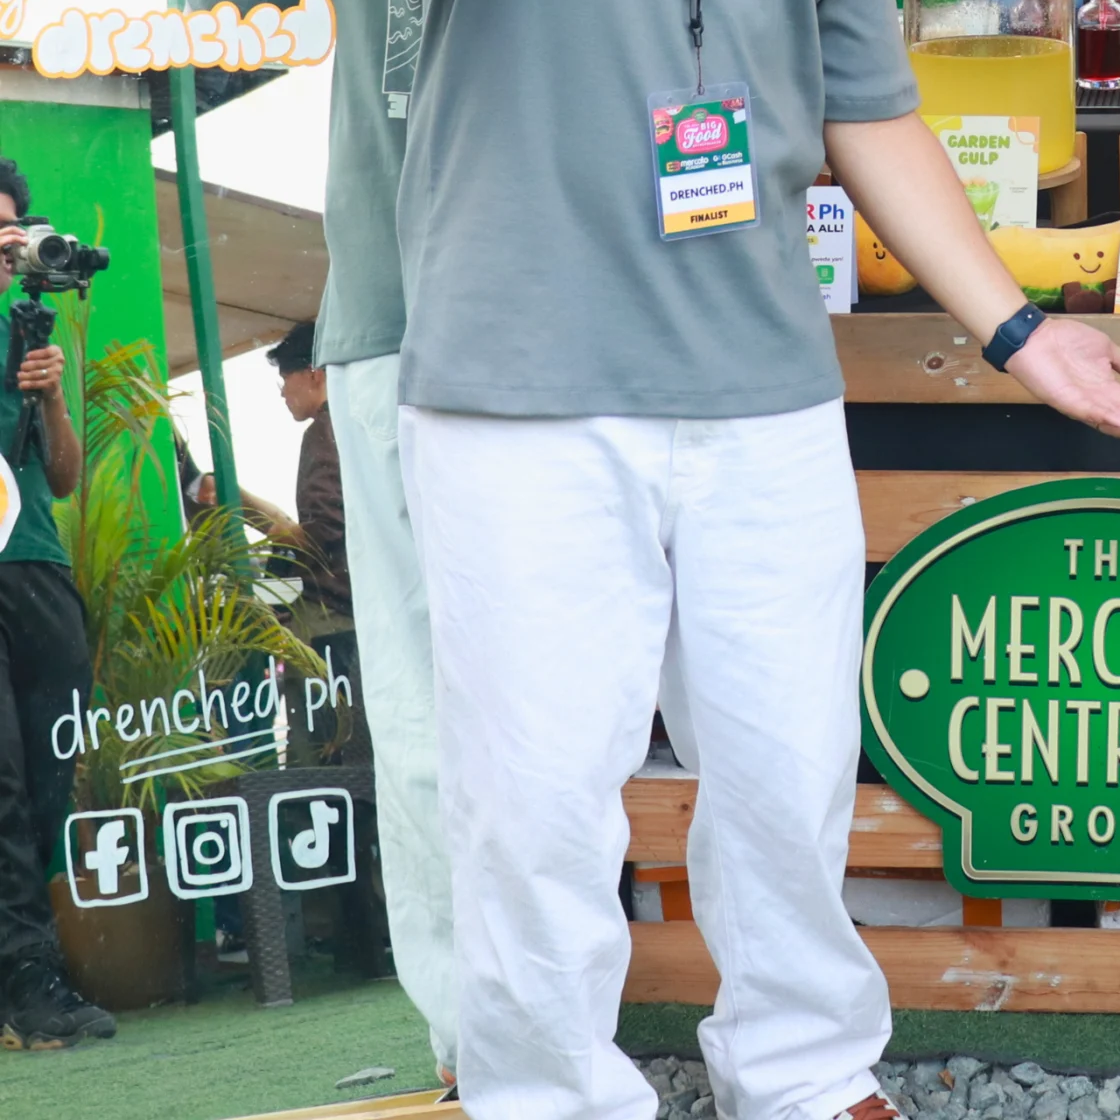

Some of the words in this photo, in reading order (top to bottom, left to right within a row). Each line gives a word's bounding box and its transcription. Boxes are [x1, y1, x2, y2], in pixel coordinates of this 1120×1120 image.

[701, 121, 717, 130] BIG
[682, 123, 722, 149] Food
[947, 134, 1011, 149] GARDEN
[958, 151, 999, 165] GULP
[670, 181, 744, 201] DRENCHED.PH
[690, 210, 729, 224] FINALIST
[819, 204, 845, 220] Ph
[818, 224, 844, 233] ALL!
